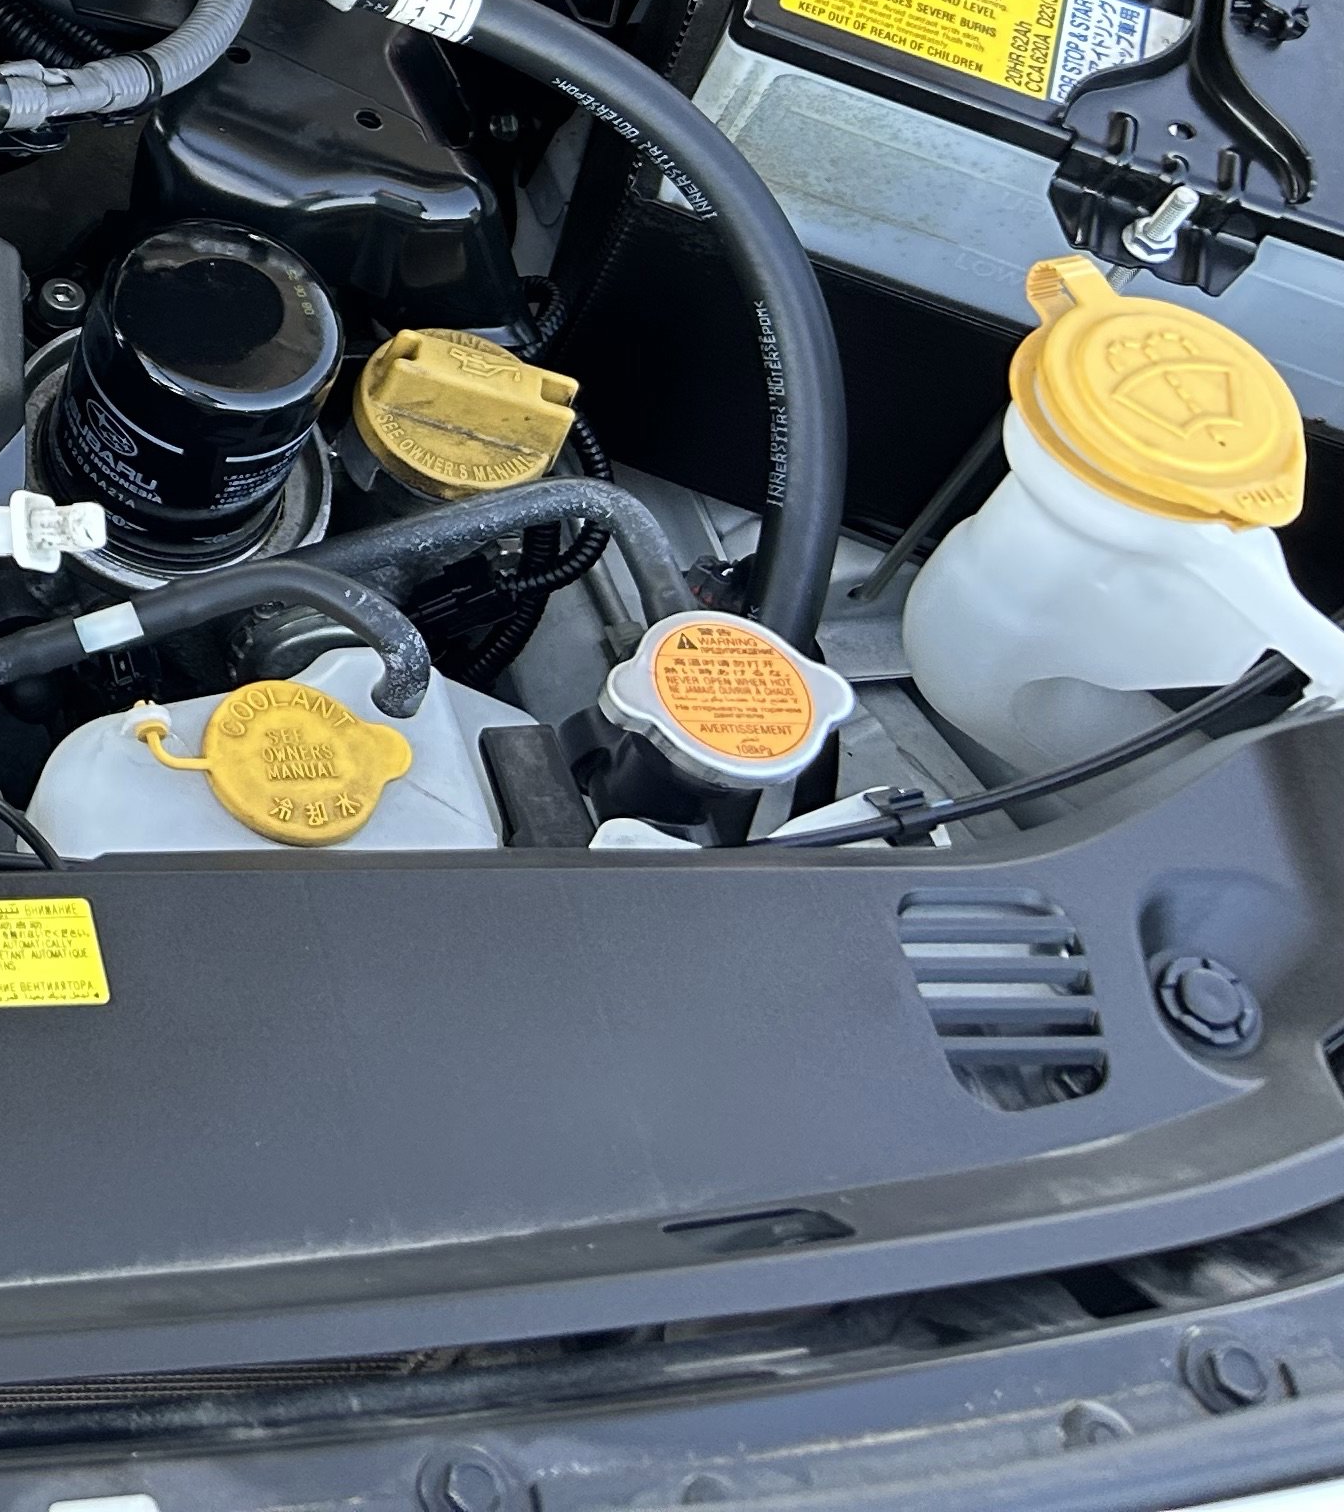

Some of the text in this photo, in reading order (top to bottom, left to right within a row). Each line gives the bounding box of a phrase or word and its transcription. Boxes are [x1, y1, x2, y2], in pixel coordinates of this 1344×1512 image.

[916, 2, 956, 22] SEVERE
[959, 17, 997, 37] BURNS
[963, 0, 997, 19] LEVEL
[798, 1, 983, 72] KEEP OUT OF REACH OF CHILDREN
[1030, 33, 1051, 64] 620A
[1068, 31, 1088, 42] &
[1005, 20, 1033, 86] 20HR 62Ah
[1062, 40, 1086, 76] STOP
[1024, 60, 1045, 93] CCA
[376, 412, 537, 482] SEE OWNER'S MANUAL
[90, 453, 163, 504] INDONESIA
[1233, 484, 1295, 510] PULL
[698, 637, 758, 648] WARNING
[666, 675, 792, 687] NEVER OPEN WHEN HOT
[220, 688, 357, 736] COOLANT
[265, 728, 303, 744] SEE
[700, 723, 792, 736] AVERTISSEMENT
[736, 744, 773, 756] 108kPa
[267, 761, 339, 780] MANUAL
[270, 792, 362, 826] 冷却水
[25, 903, 77, 916] ВНИМАНИЕ
